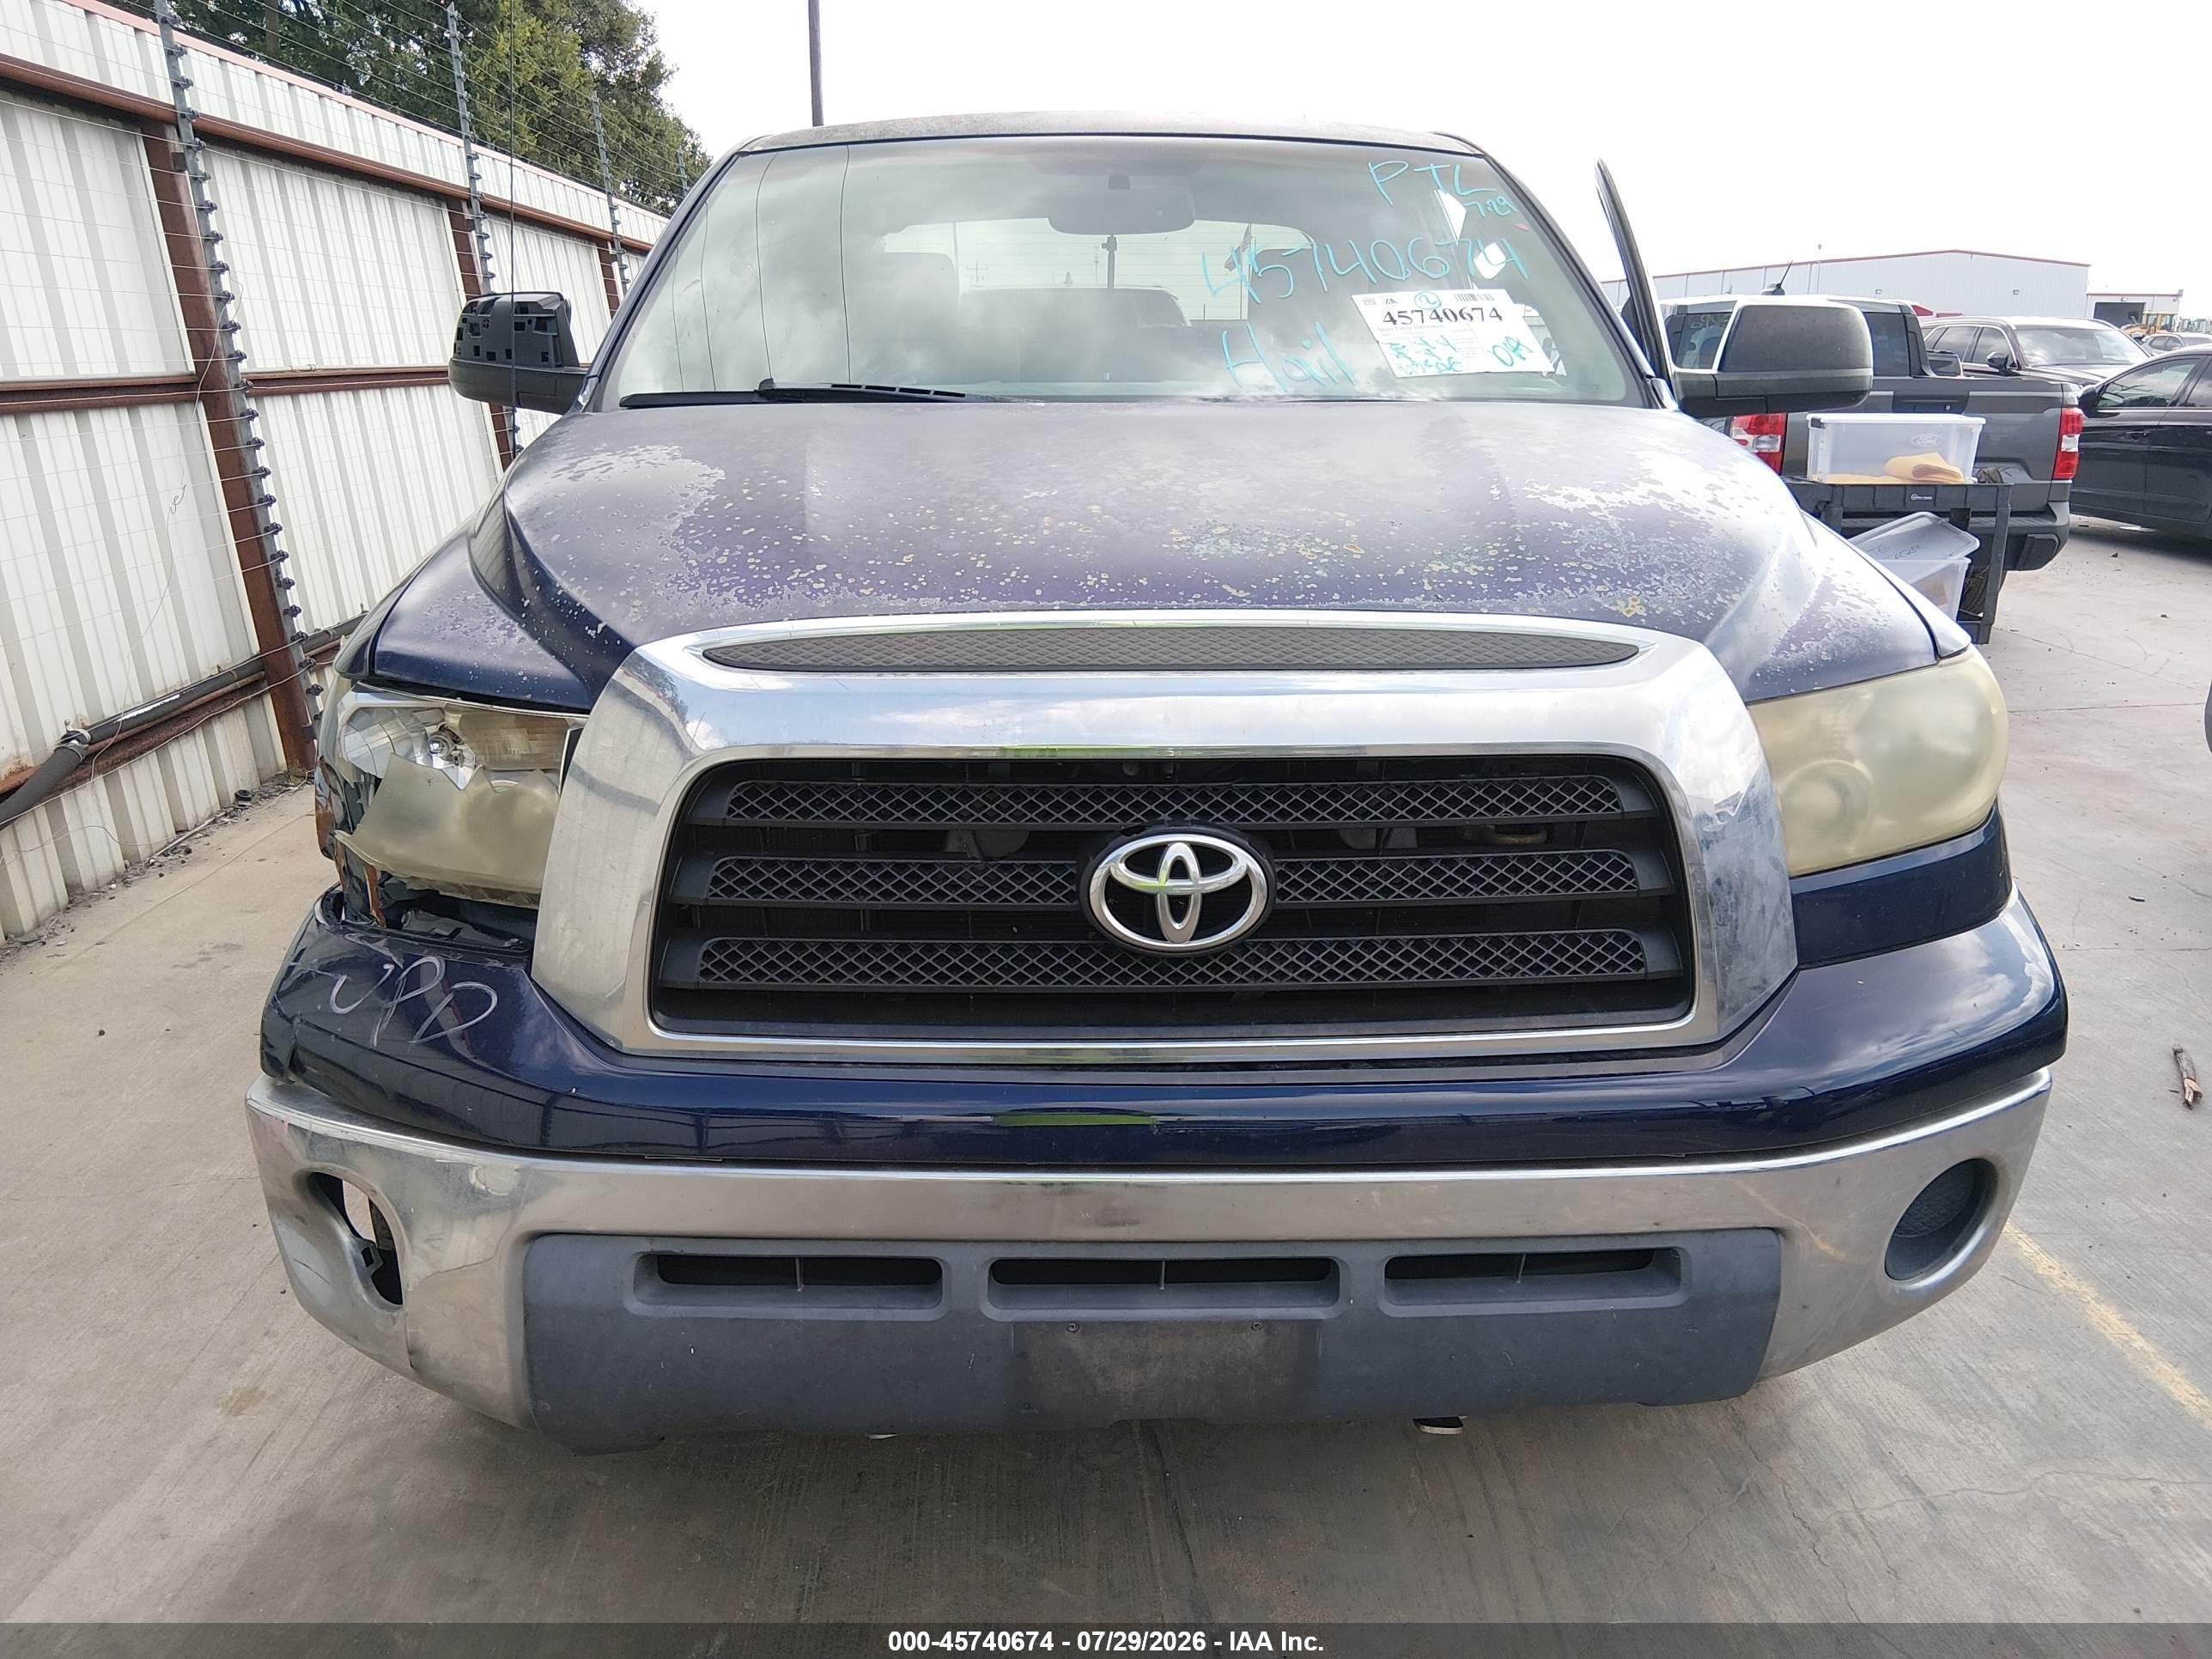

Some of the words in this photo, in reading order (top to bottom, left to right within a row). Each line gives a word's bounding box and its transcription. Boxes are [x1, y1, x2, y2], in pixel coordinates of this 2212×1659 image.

[1201, 238, 1528, 304] 45740674
[1383, 307, 1504, 325] 45740674
[1222, 321, 1356, 392] Hail
